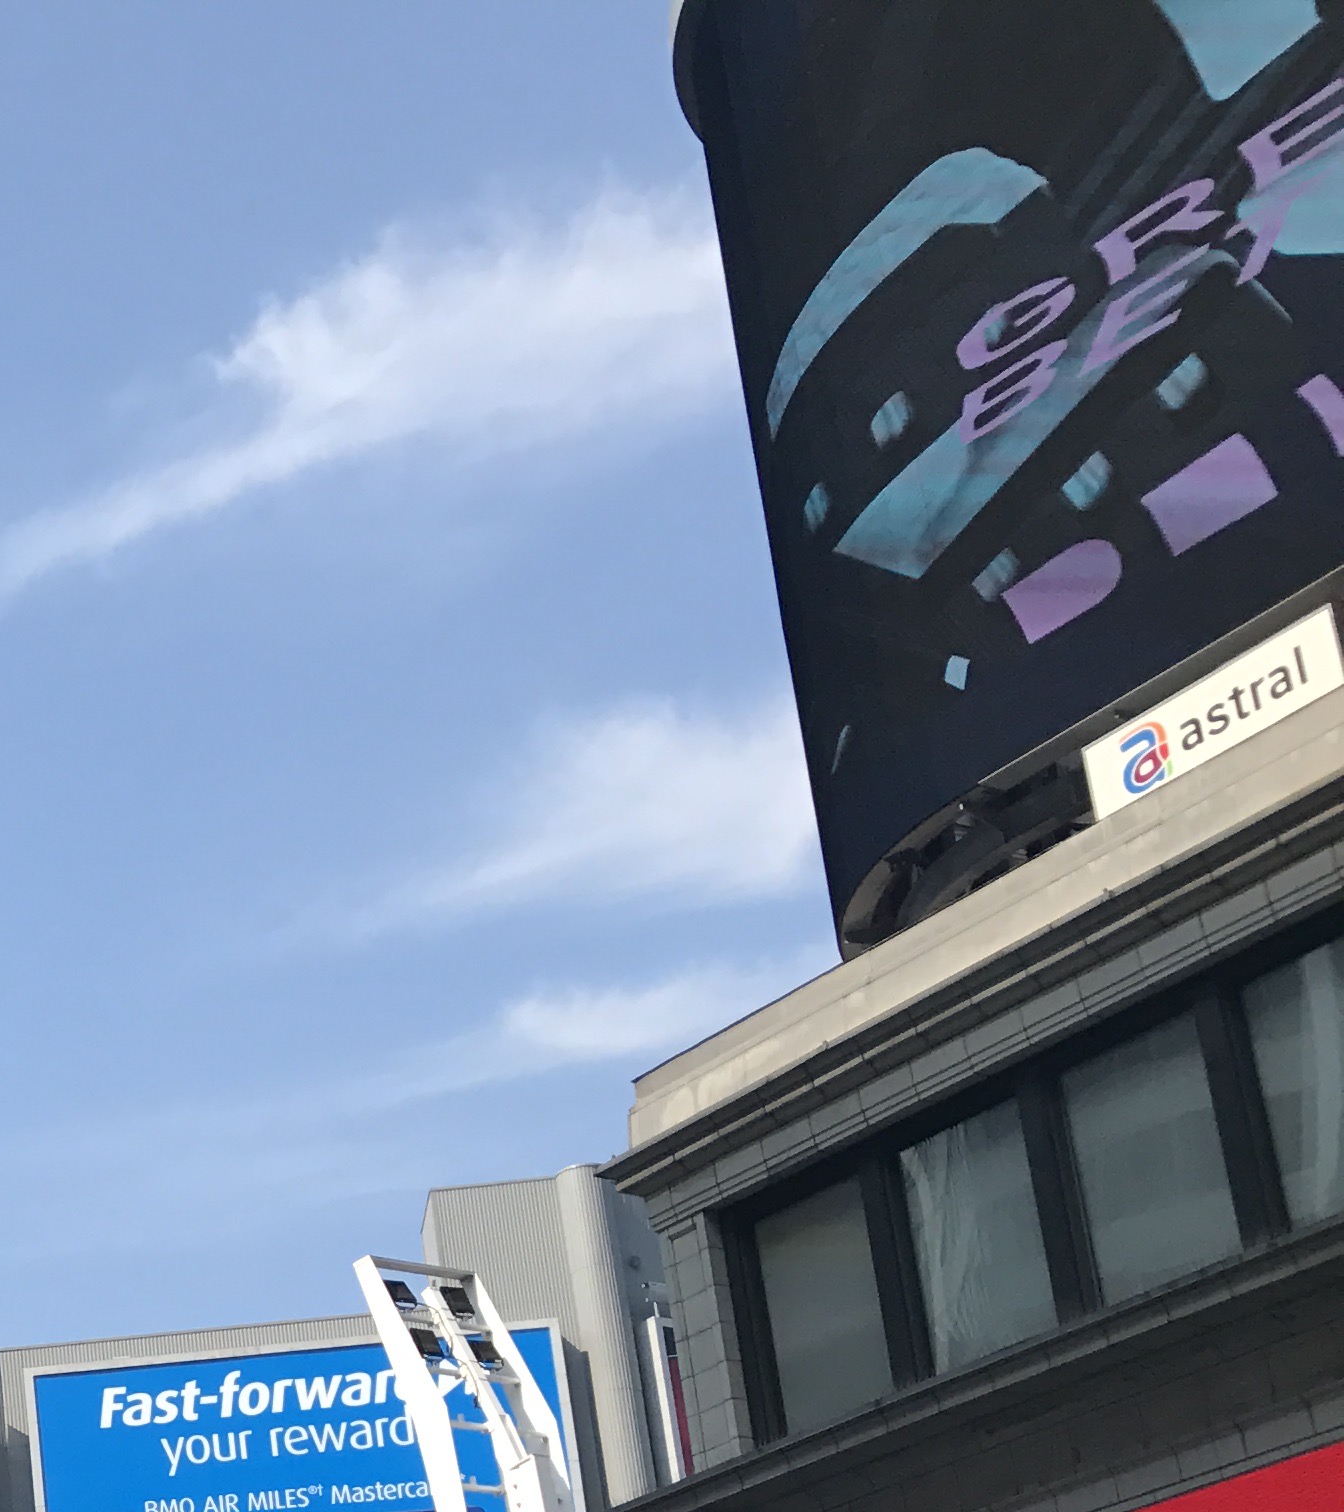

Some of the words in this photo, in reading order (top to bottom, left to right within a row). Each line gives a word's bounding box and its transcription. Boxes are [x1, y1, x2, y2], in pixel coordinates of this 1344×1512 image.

[1179, 644, 1309, 751] astral
[160, 1429, 252, 1477] your
[269, 1414, 419, 1459] reward
[330, 1480, 430, 1506] Masterca
